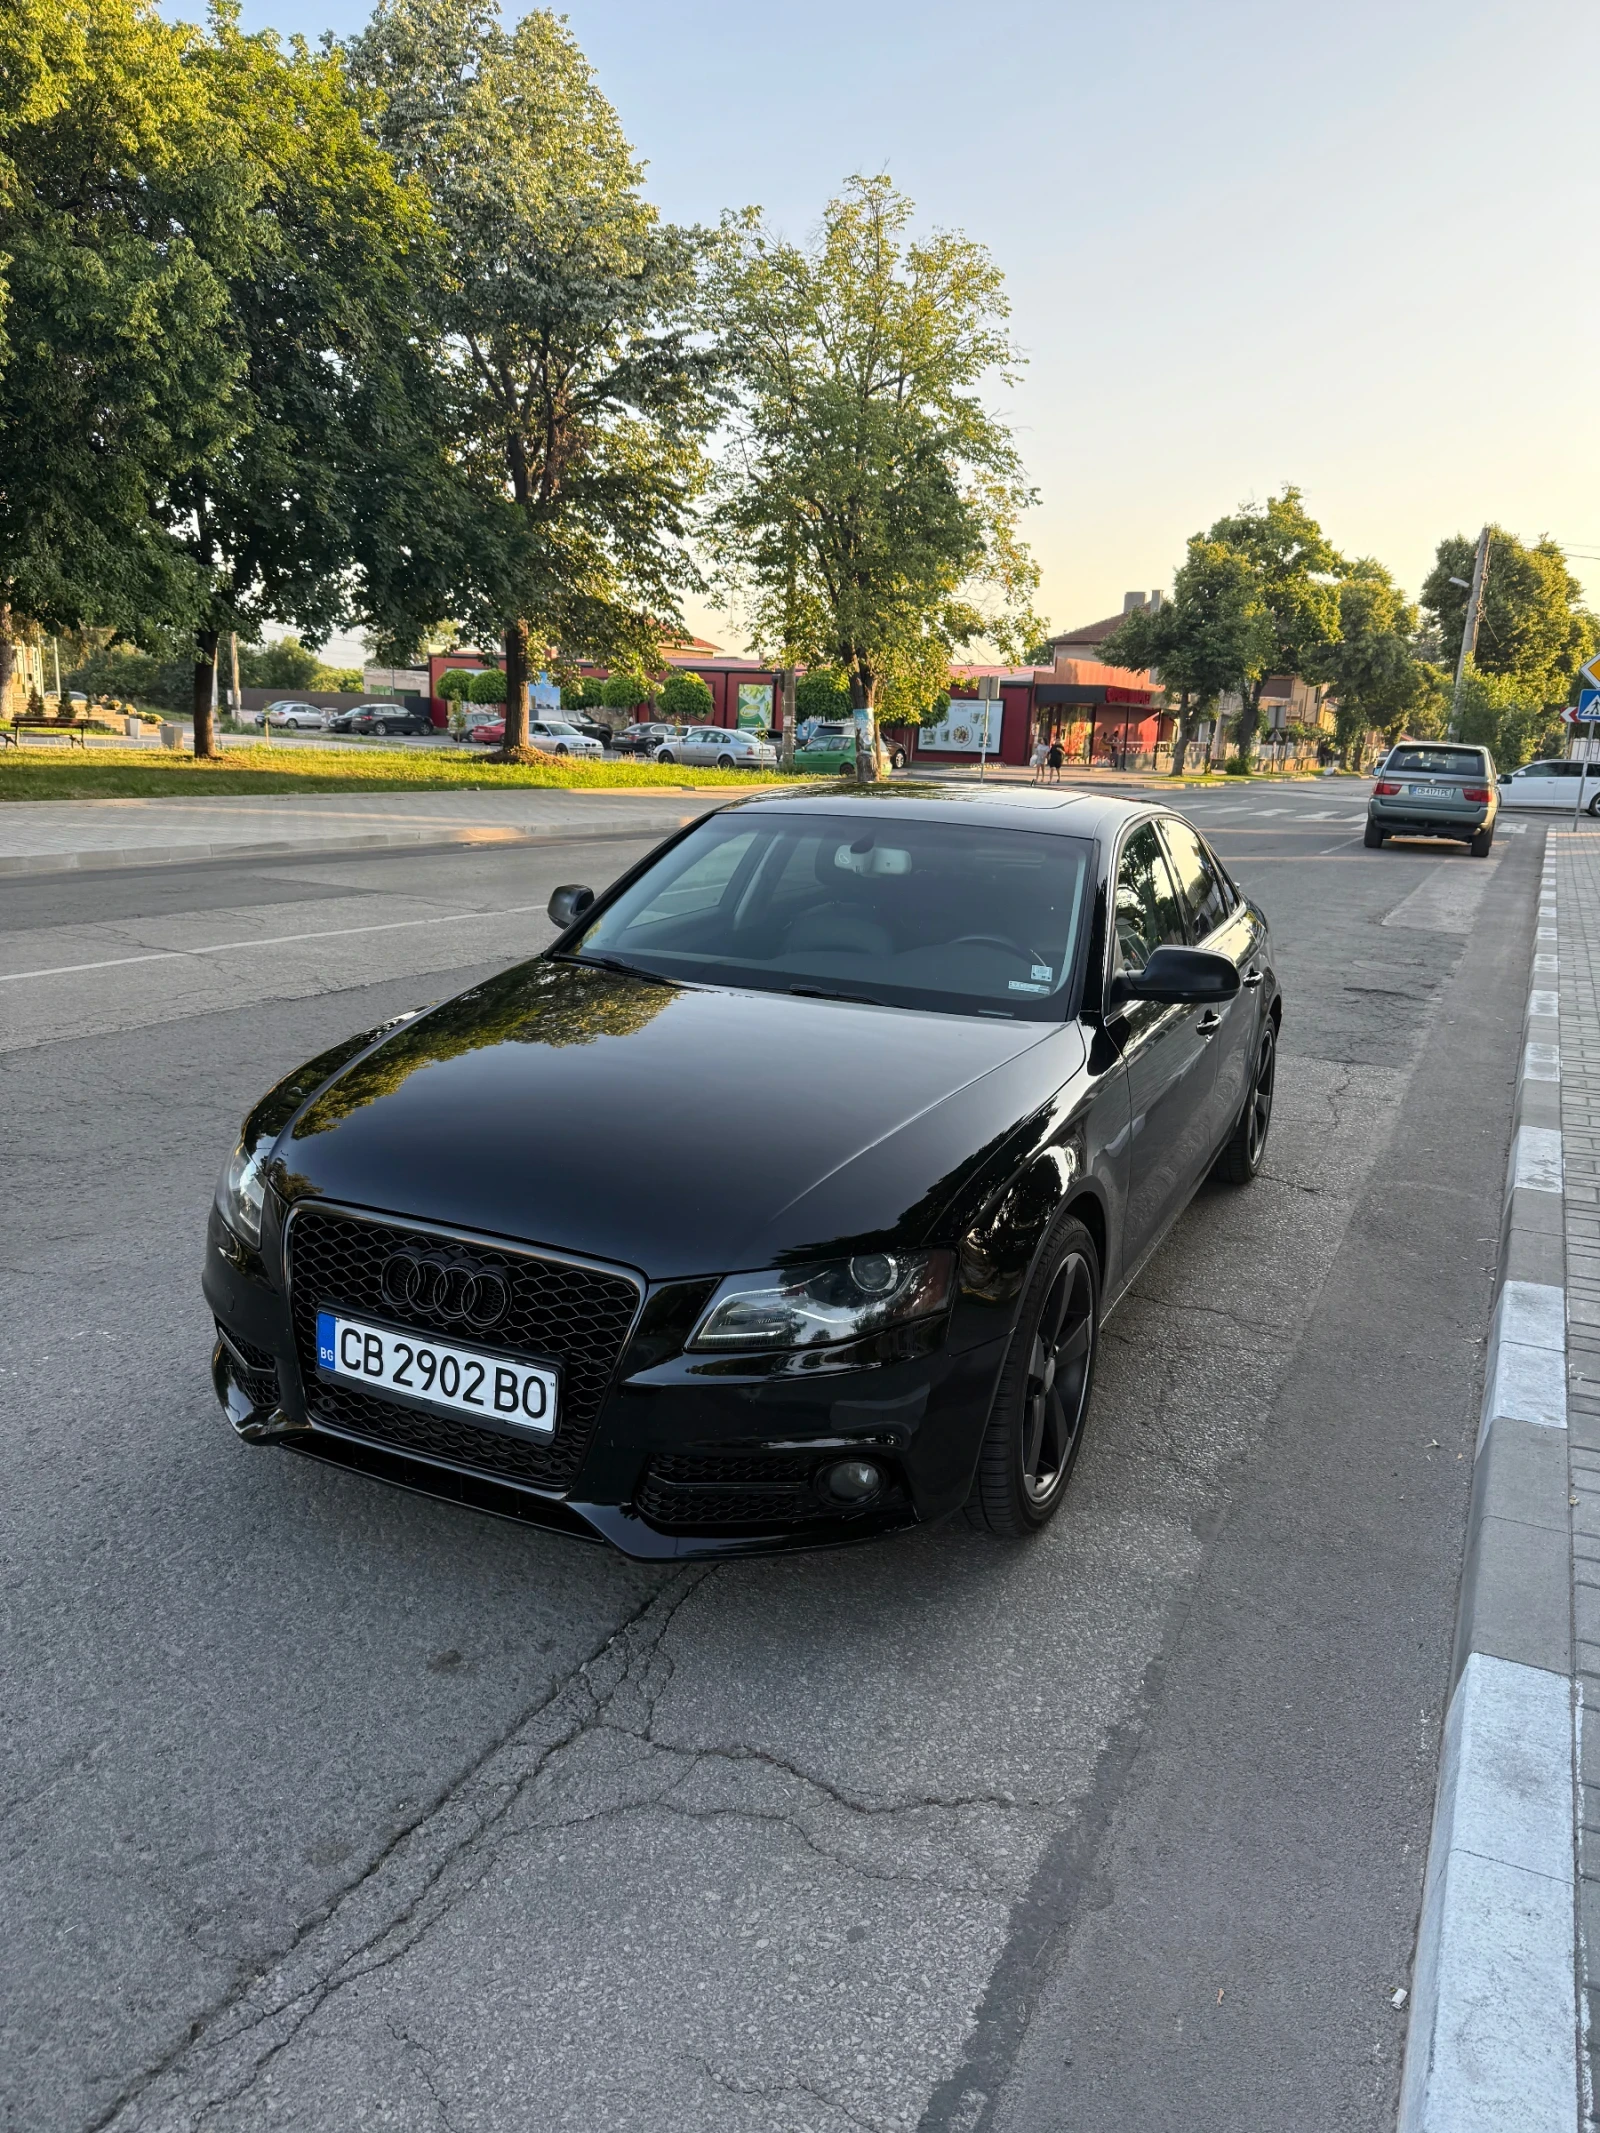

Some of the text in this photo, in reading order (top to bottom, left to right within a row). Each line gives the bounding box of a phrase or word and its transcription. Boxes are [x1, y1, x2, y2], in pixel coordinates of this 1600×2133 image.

[320, 1346, 334, 1362] BG
[340, 1327, 547, 1419] CB 2902 BO
